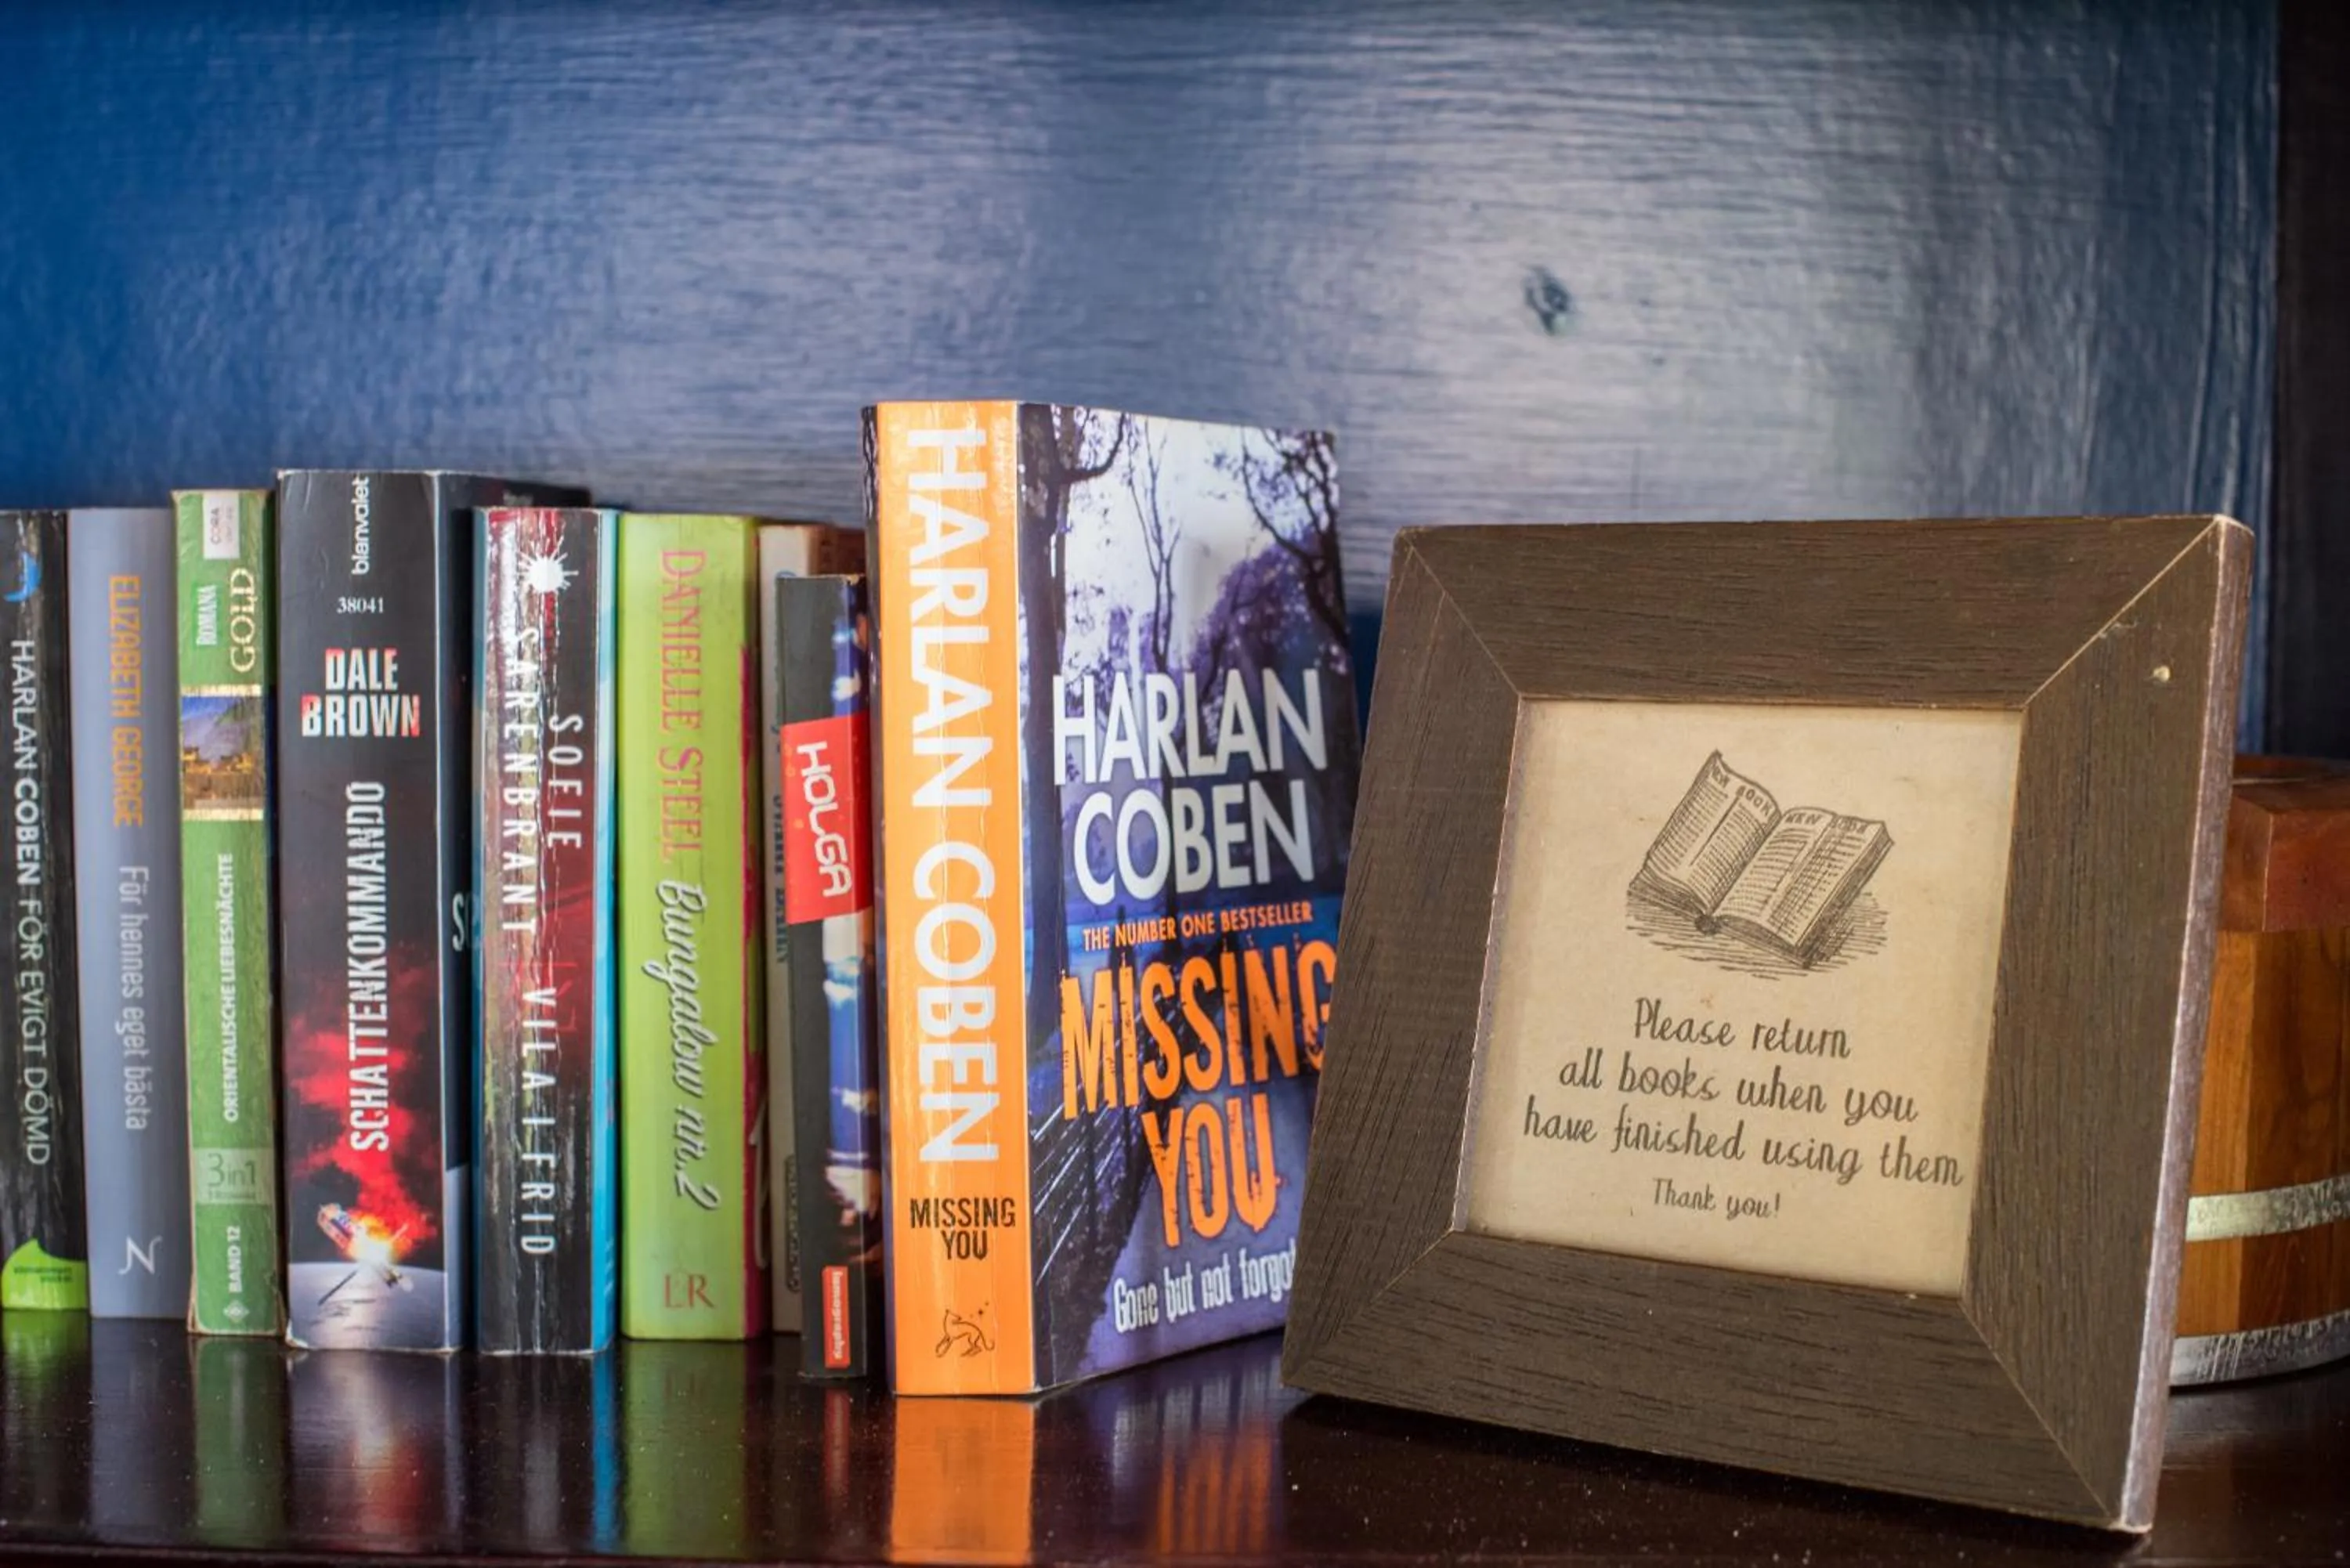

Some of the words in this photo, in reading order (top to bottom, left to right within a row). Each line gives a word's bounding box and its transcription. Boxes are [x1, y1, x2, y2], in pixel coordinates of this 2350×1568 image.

[350, 475, 371, 576] blanvalet
[108, 575, 143, 717] ELIZABETH
[196, 583, 217, 646] ROMANA
[230, 567, 258, 673] GOLD
[337, 596, 385, 614] 38041
[657, 550, 707, 735] DANIELLE
[907, 428, 994, 807] HARLAN
[11, 639, 38, 770] HARLAN
[301, 694, 421, 737] BROWN
[324, 648, 398, 691] DALE
[1052, 667, 1328, 786] HARLAN
[111, 725, 143, 829] GEORGE
[501, 627, 540, 935] SARENBRANT
[548, 714, 584, 850] SOFIE
[655, 744, 704, 865] STEEL
[797, 740, 852, 898] HOLGA
[13, 778, 41, 886] COBEN
[1073, 779, 1314, 906] COBEN
[18, 898, 44, 960] FÖR
[119, 865, 150, 907] För
[1083, 927, 1110, 952] THE
[1115, 919, 1177, 946] NUMBER
[1181, 912, 1216, 936] ONE
[1220, 900, 1314, 932] BESTSELLER
[120, 912, 150, 999] hennes
[346, 780, 389, 1152] SCHATTENKOMMANDO
[642, 878, 718, 1099] Bungalow
[912, 840, 1000, 1162] COBEN
[19, 970, 47, 1057] EVIGT
[115, 1008, 152, 1057] eget
[1060, 940, 1337, 1120] MISSING
[1634, 996, 1736, 1047] Please
[1752, 1018, 1851, 1060] return
[23, 1066, 50, 1166] DÖMD
[123, 1065, 152, 1132] bästa
[1559, 1046, 1603, 1089] all
[1618, 1050, 1720, 1101] books
[1737, 1064, 1827, 1115] when
[1844, 1086, 1919, 1126] you
[1141, 1093, 1282, 1248] YOU
[1524, 1094, 1597, 1144] have
[1611, 1103, 1746, 1162] finished
[1762, 1138, 1864, 1185] using
[1880, 1135, 1965, 1187] them
[226, 1225, 241, 1242] 12
[909, 1197, 1017, 1230] MISSING
[940, 1230, 989, 1260] YOU
[1652, 1177, 1716, 1212] Thank
[1726, 1191, 1782, 1221] you!
[227, 1245, 243, 1293] BAND
[1113, 1277, 1159, 1334] Gone
[1163, 1264, 1195, 1323] but
[1202, 1254, 1232, 1311] not
